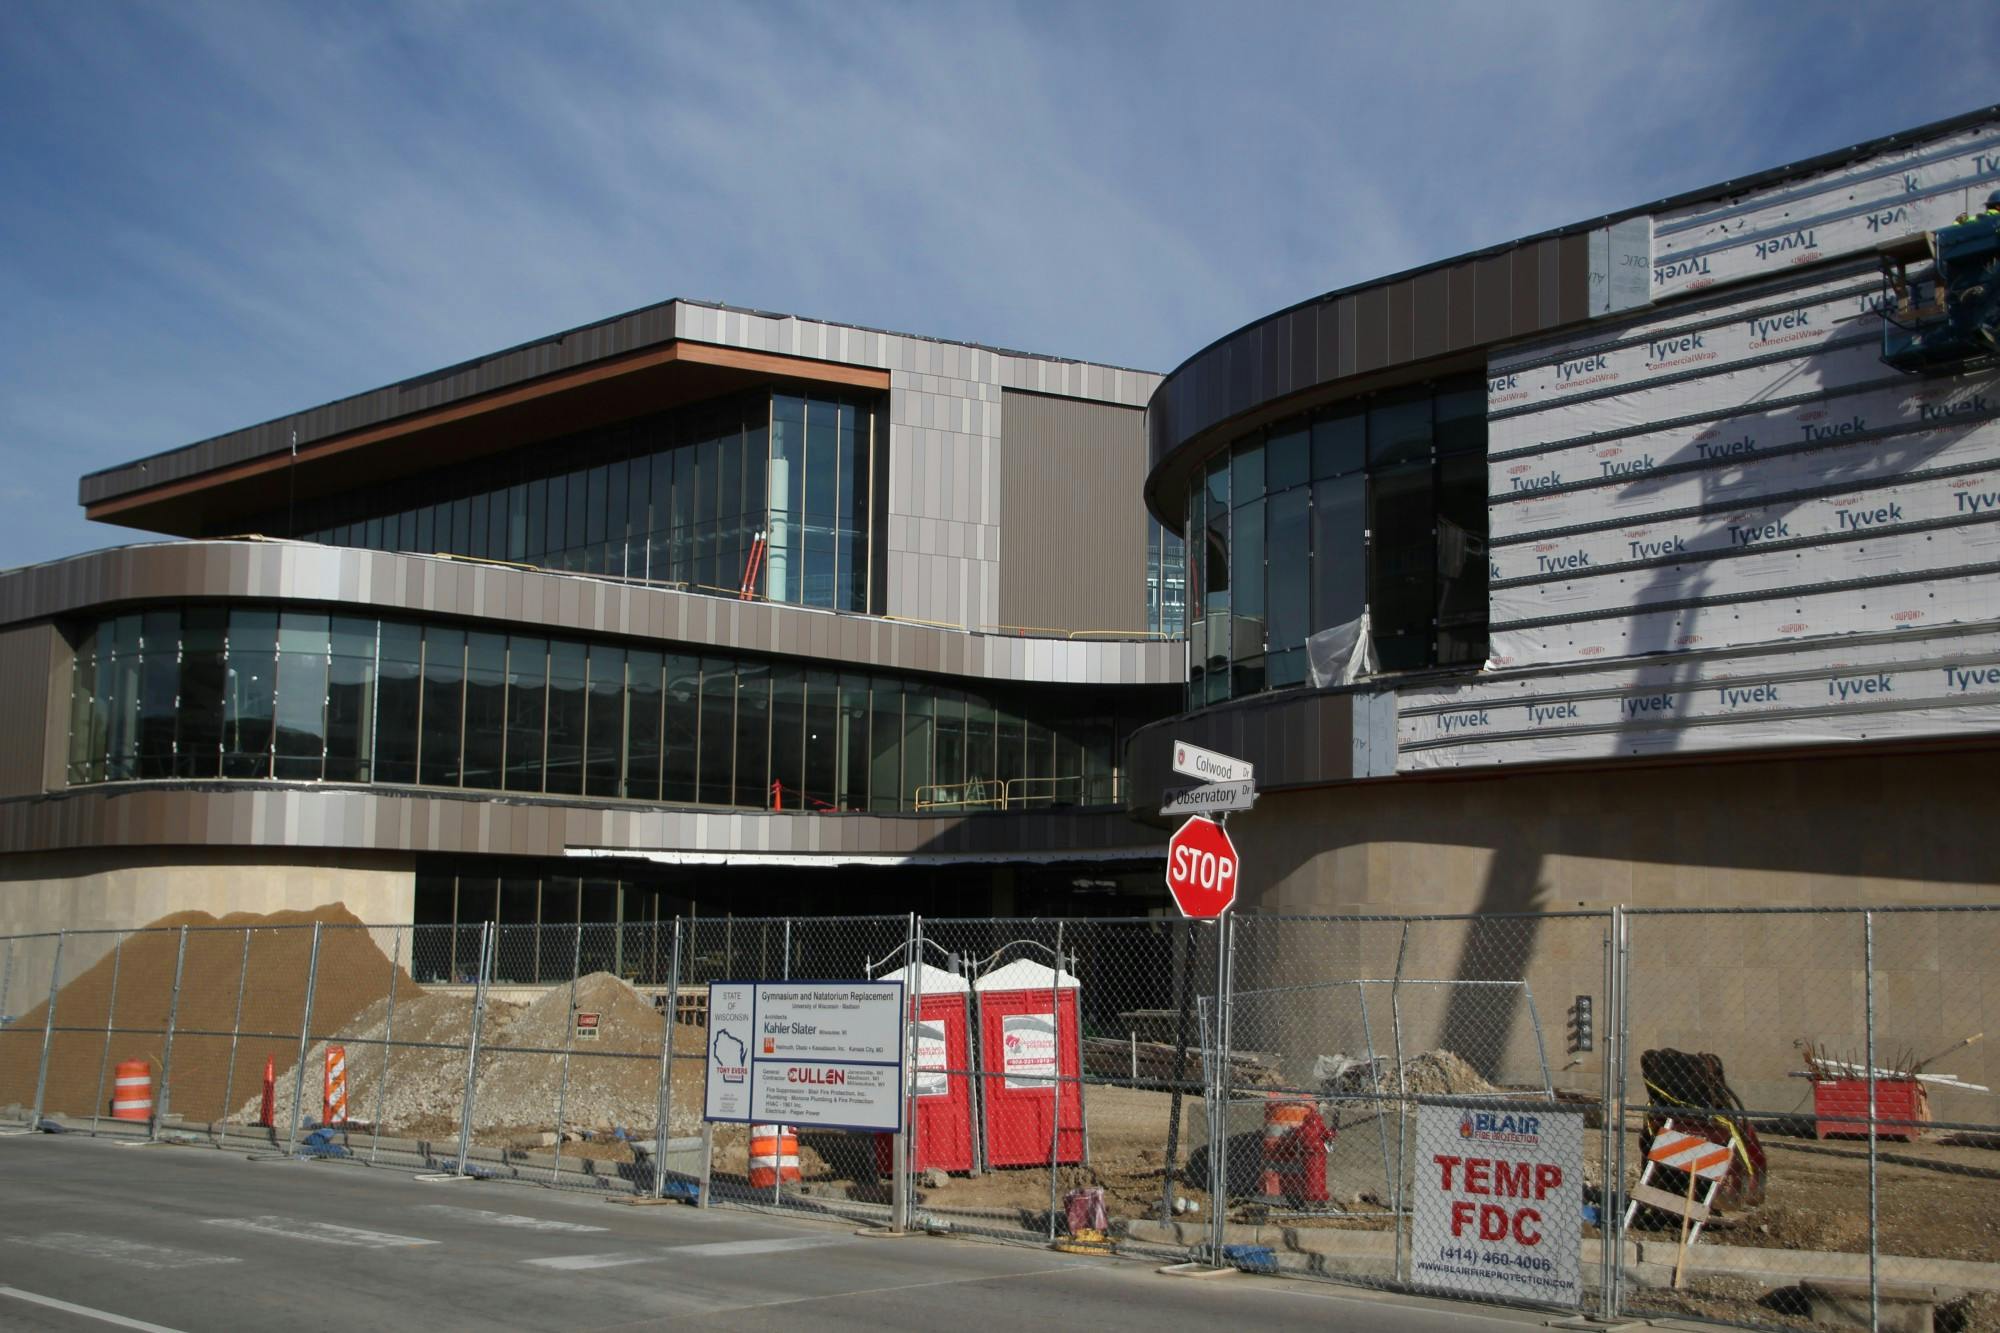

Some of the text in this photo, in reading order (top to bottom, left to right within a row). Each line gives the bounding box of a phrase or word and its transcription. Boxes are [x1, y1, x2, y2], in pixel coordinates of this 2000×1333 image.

[1755, 230, 1817, 260] Tyvek
[1653, 256, 1711, 285] Tyvek
[1749, 311, 1808, 342] Tyvek
[1648, 333, 1703, 361] Tyvek
[1555, 353, 1606, 381] Tyvek
[1801, 416, 1865, 440] Tyvek
[1696, 436, 1756, 459] Tyvek
[1600, 454, 1655, 477] Tyvek
[1511, 471, 1560, 491] Tyvek
[1835, 503, 1902, 529] Tyvek
[1728, 519, 1788, 546] Tyvek
[1629, 535, 1686, 558] Tyvek
[1537, 550, 1589, 573] Tyvek
[1719, 682, 1778, 707] Tyvek
[1828, 674, 1891, 700] Tyvek
[1525, 702, 1577, 725] Tyvek
[1620, 693, 1673, 717] Tyvek
[1437, 711, 1489, 733] Tyvek
[1196, 755, 1250, 779] Colwood Dr
[1176, 785, 1250, 804] Observatory Dr
[1172, 844, 1233, 892] STOP
[722, 991, 743, 1000] STATE
[728, 1002, 737, 1010] OF
[762, 991, 894, 1003] Gymnasium and Natatorium Replacement
[715, 1013, 749, 1021] WISCONSIN
[763, 1022, 816, 1035] Kahler Slater
[716, 1066, 730, 1074] TONY
[732, 1067, 748, 1075] EVERS
[788, 1067, 845, 1085] CULLEN
[1475, 1113, 1540, 1135] BLAIR
[1474, 1131, 1539, 1144] FIRE PROTECTION
[1433, 1154, 1563, 1200] TEMP
[1451, 1201, 1542, 1246] FDC
[1440, 1246, 1551, 1271] (414) 460-4006
[1417, 1262, 1574, 1289] WWW.BLAIRFIREPROTECTION.COM
